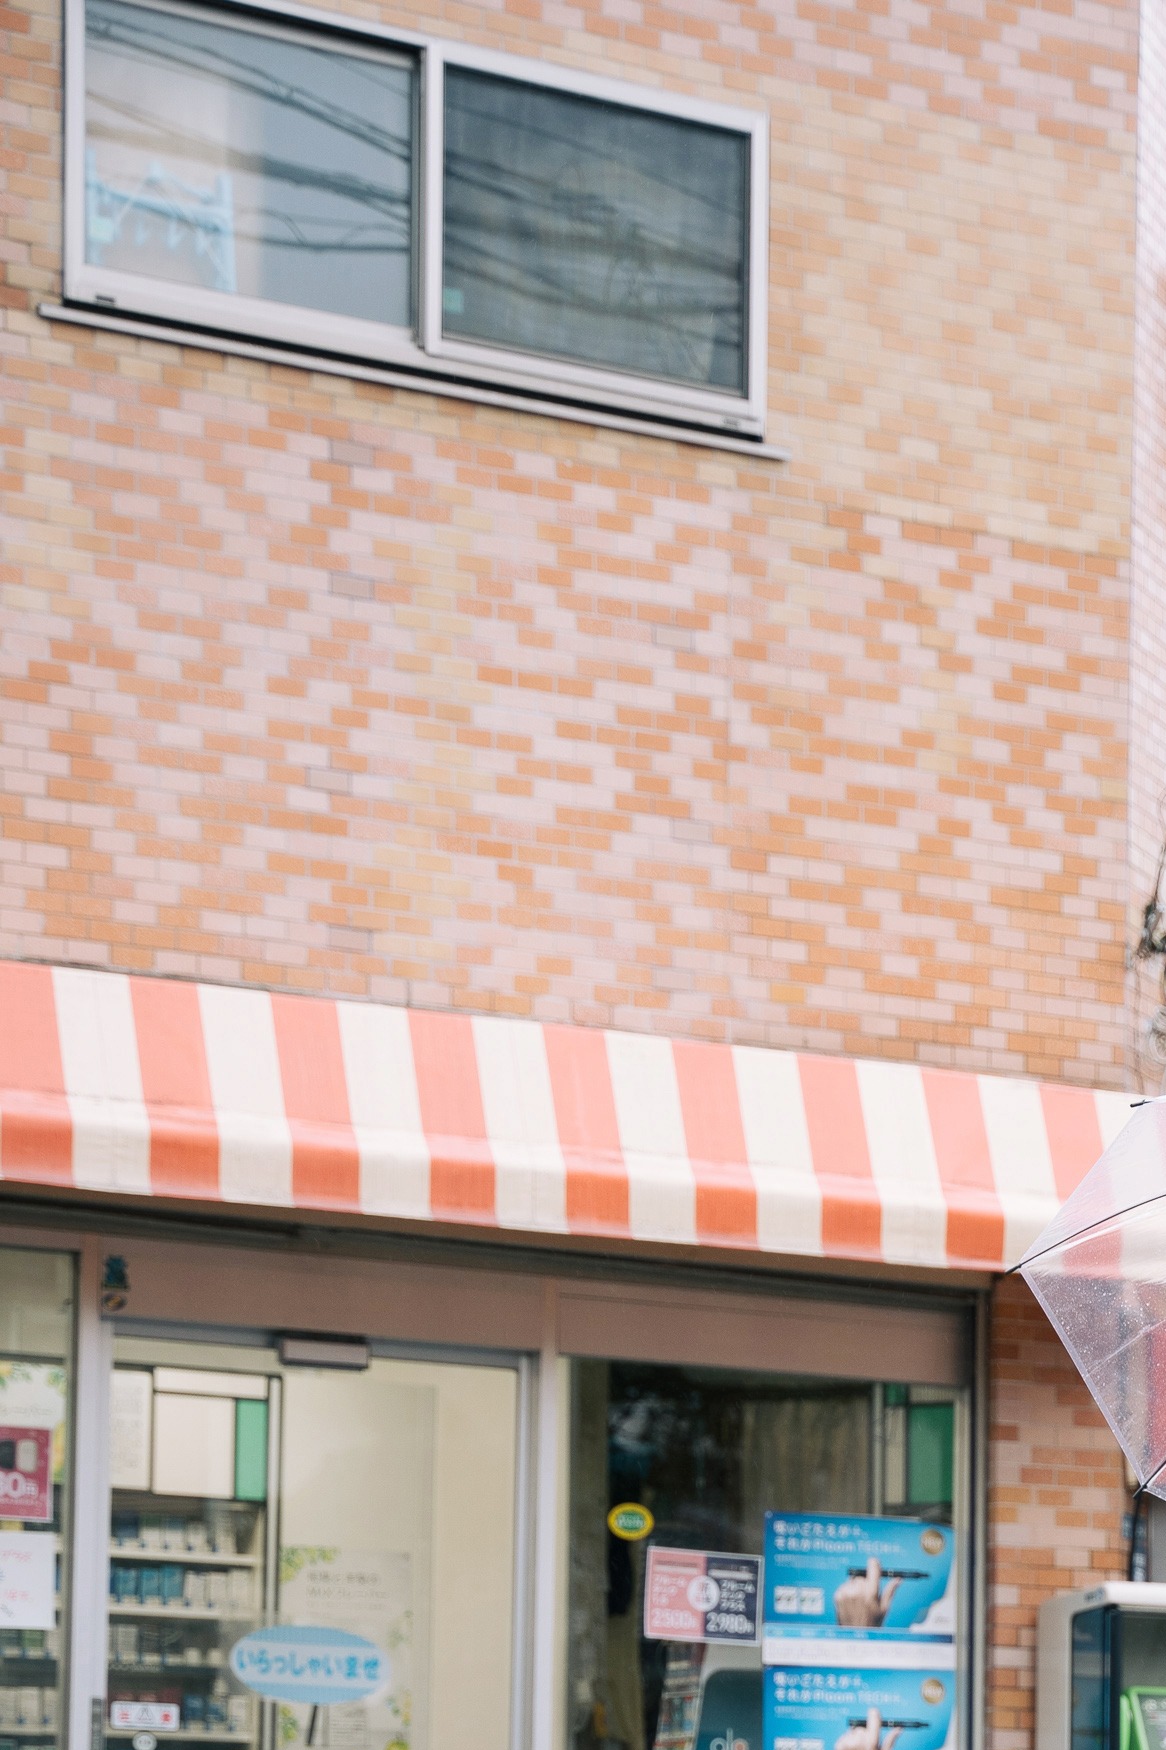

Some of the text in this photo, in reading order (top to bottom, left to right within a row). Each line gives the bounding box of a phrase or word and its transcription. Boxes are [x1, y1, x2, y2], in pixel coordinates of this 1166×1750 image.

[235, 1648, 380, 1681] いらっしゃいませ
